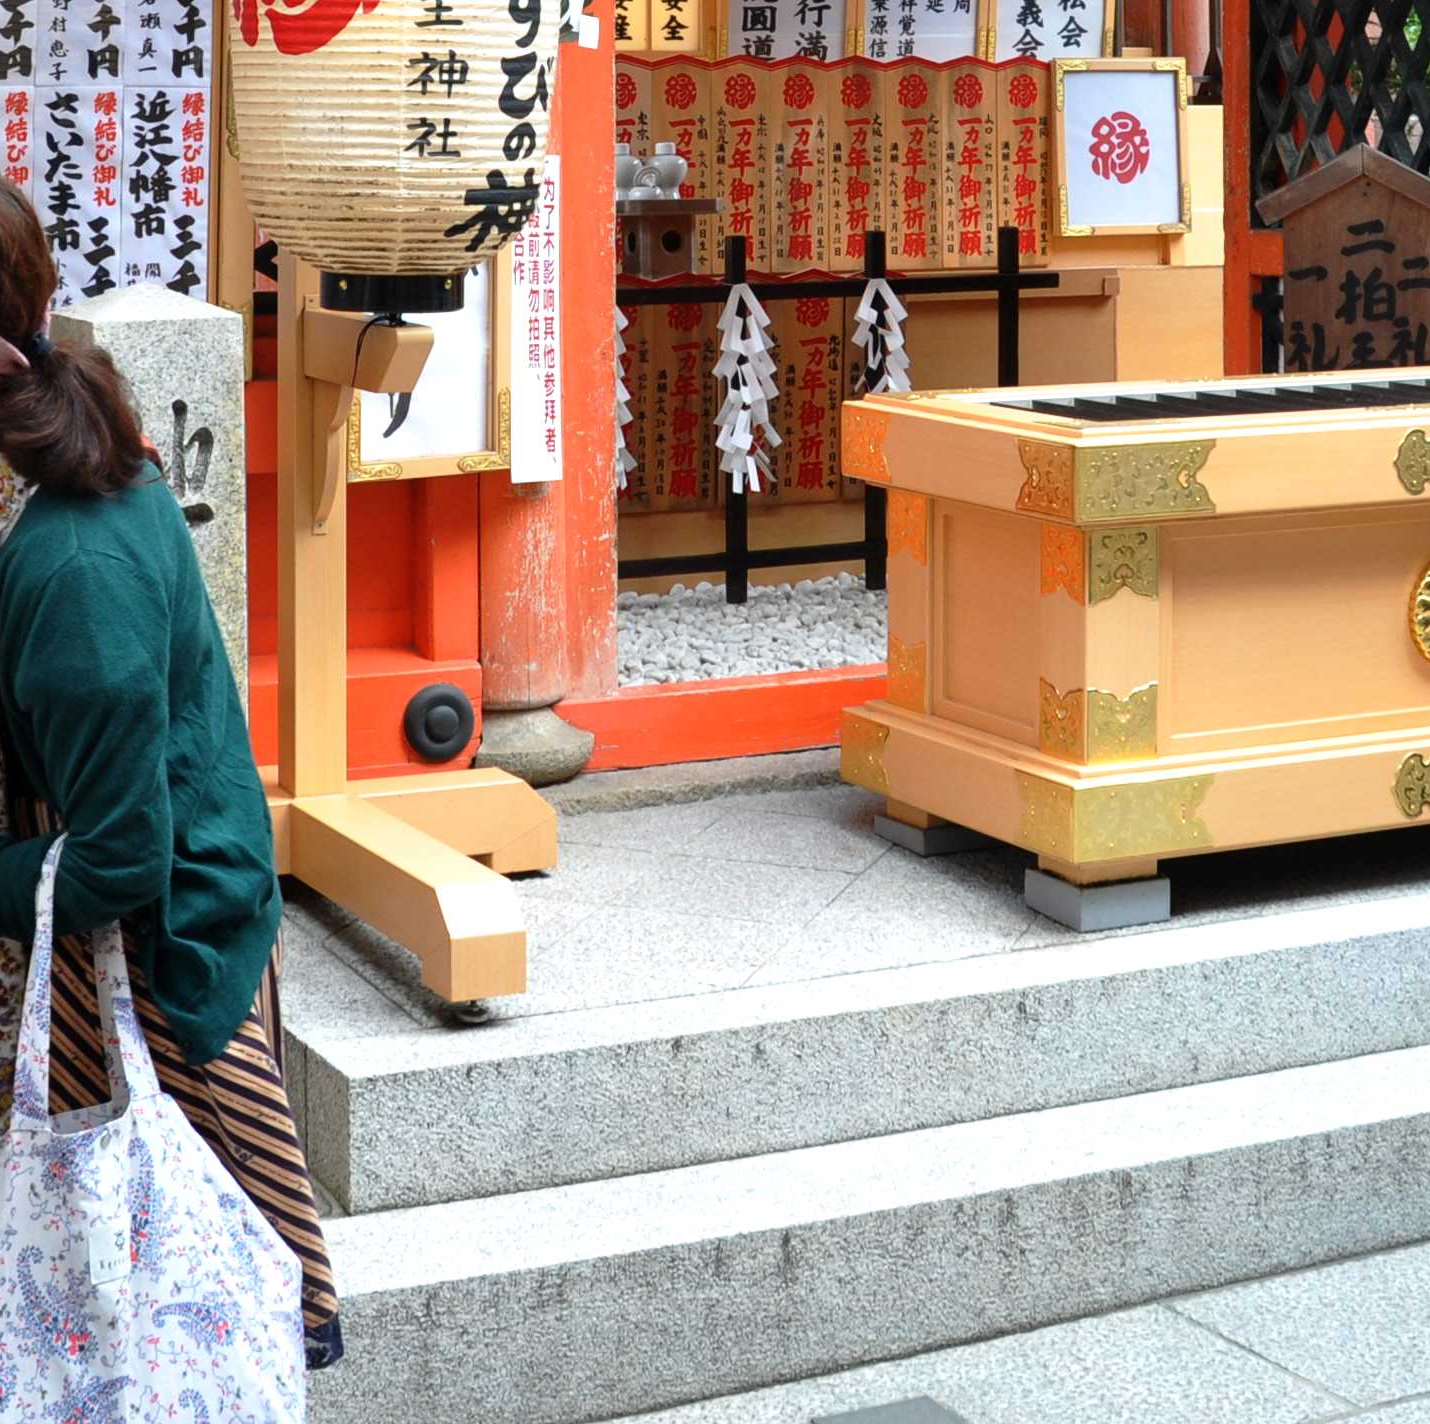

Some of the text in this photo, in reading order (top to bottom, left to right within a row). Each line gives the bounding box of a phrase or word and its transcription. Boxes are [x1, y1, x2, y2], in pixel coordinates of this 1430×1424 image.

[44, 92, 84, 252] さいたま市
[93, 92, 118, 208] 縁結び御礼
[128, 92, 179, 239] 近江八幡市
[181, 92, 205, 207] 縁結び御礼
[1089, 111, 1150, 184] 縁
